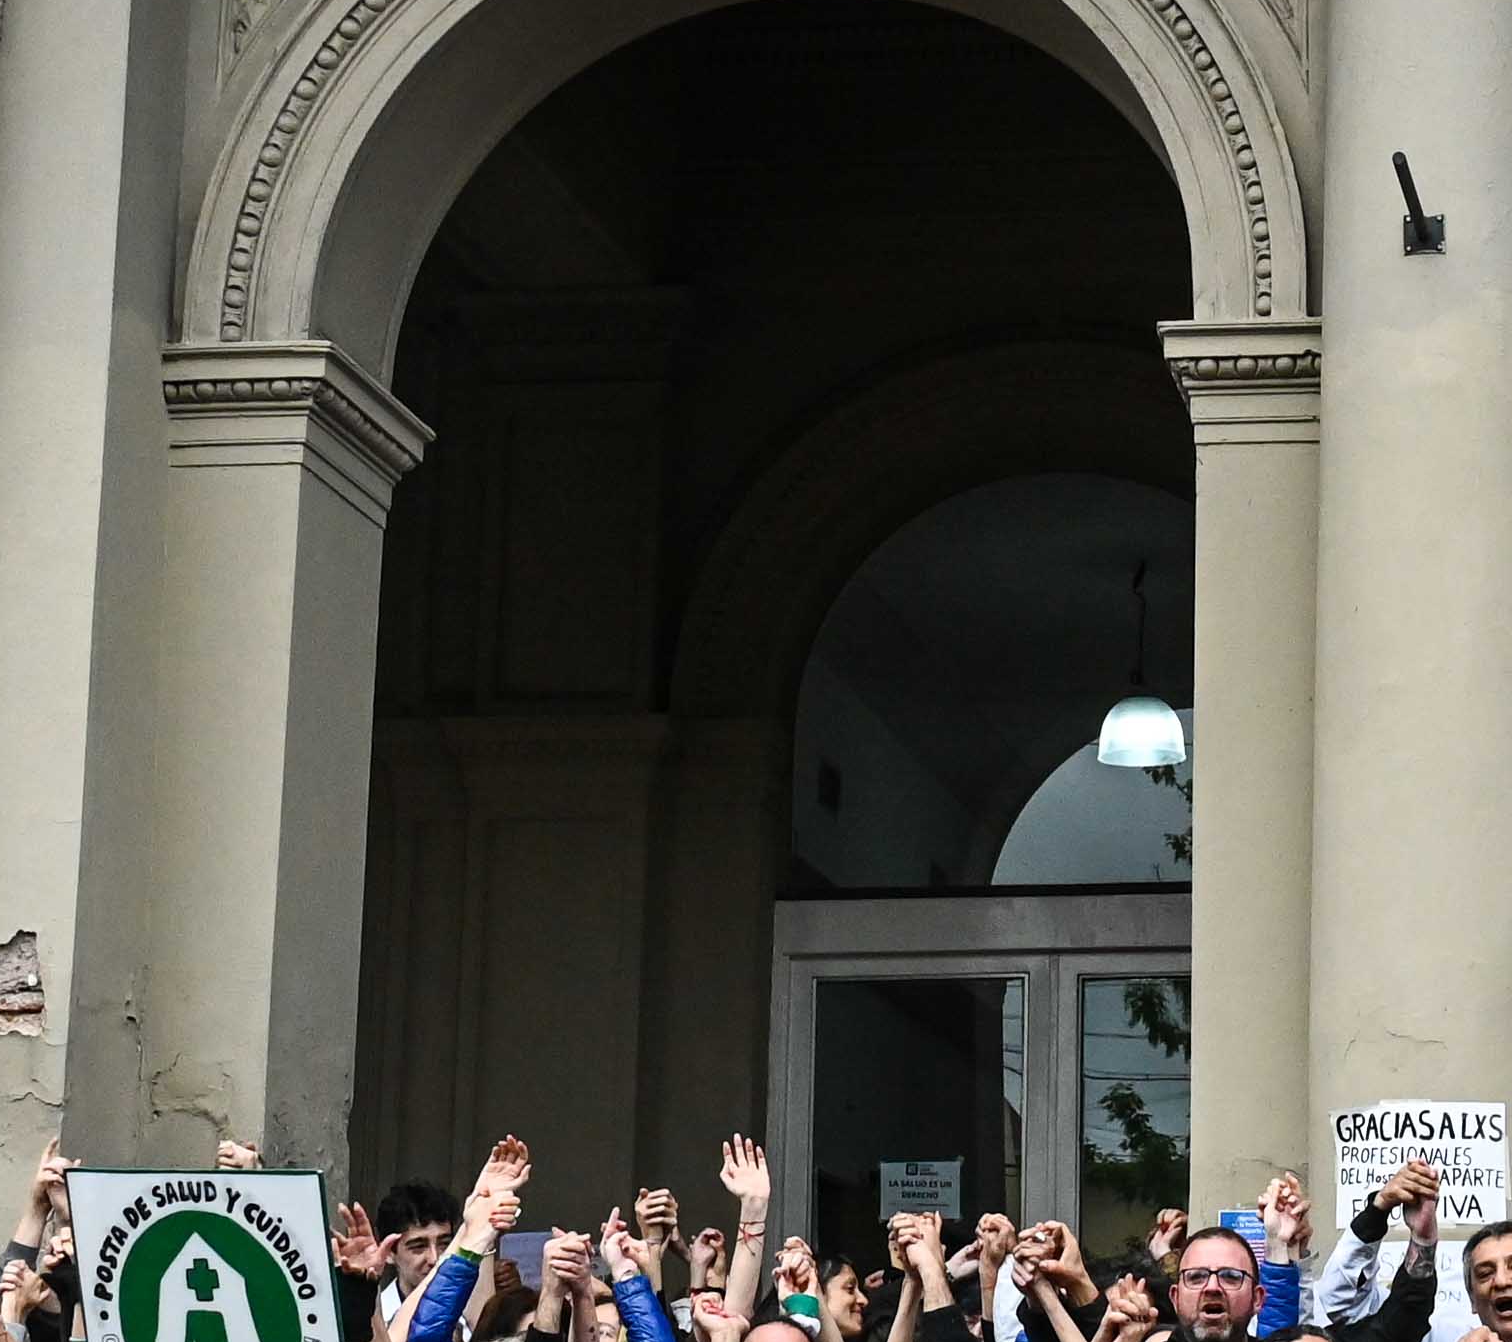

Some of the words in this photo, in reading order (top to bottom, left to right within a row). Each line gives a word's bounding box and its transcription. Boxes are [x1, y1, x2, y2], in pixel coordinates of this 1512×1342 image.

[1336, 1110, 1435, 1142] GRACIAS
[1439, 1112, 1455, 1140] A
[1461, 1113, 1503, 1142] LXS
[1341, 1146, 1472, 1166] PROFESIONALES
[1340, 1168, 1362, 1185] DEL
[1439, 1168, 1505, 1189] APARTE
[94, 1226, 129, 1302] POSTA
[122, 1196, 152, 1229] DE
[151, 1180, 217, 1208] SALUD
[225, 1187, 241, 1214] Y
